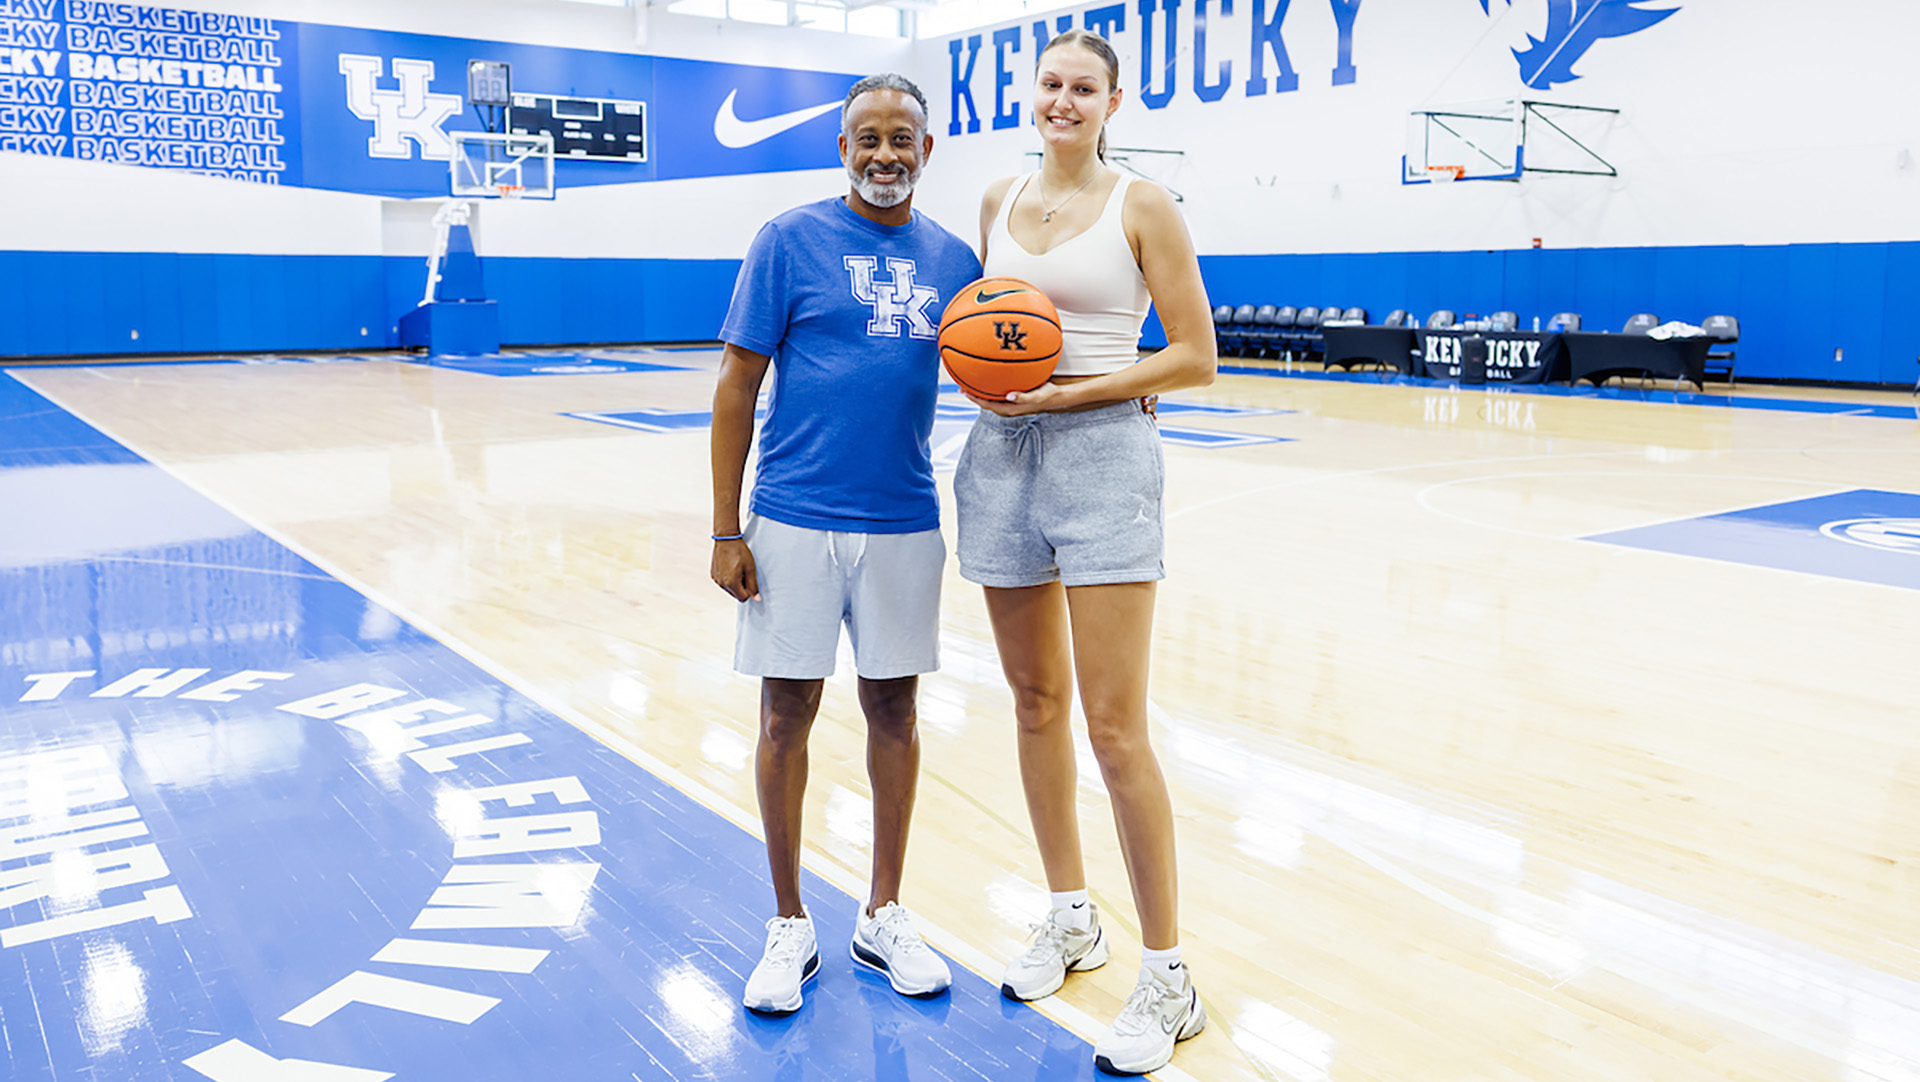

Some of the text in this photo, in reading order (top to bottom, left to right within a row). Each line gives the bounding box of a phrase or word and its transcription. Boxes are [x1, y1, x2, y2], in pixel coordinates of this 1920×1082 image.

[64, 0, 280, 40] BASKETBALL
[66, 24, 281, 66] BASKETBALL
[69, 52, 282, 92] BASKETBALL
[69, 80, 284, 119] BASKETBALL
[339, 53, 462, 161] UK
[71, 109, 285, 145] BASKETBALL
[73, 137, 286, 171] BASKETBALL
[843, 256, 939, 340] UK
[993, 321, 1028, 351] UK
[18, 668, 295, 702] THE
[275, 682, 533, 773] BELL
